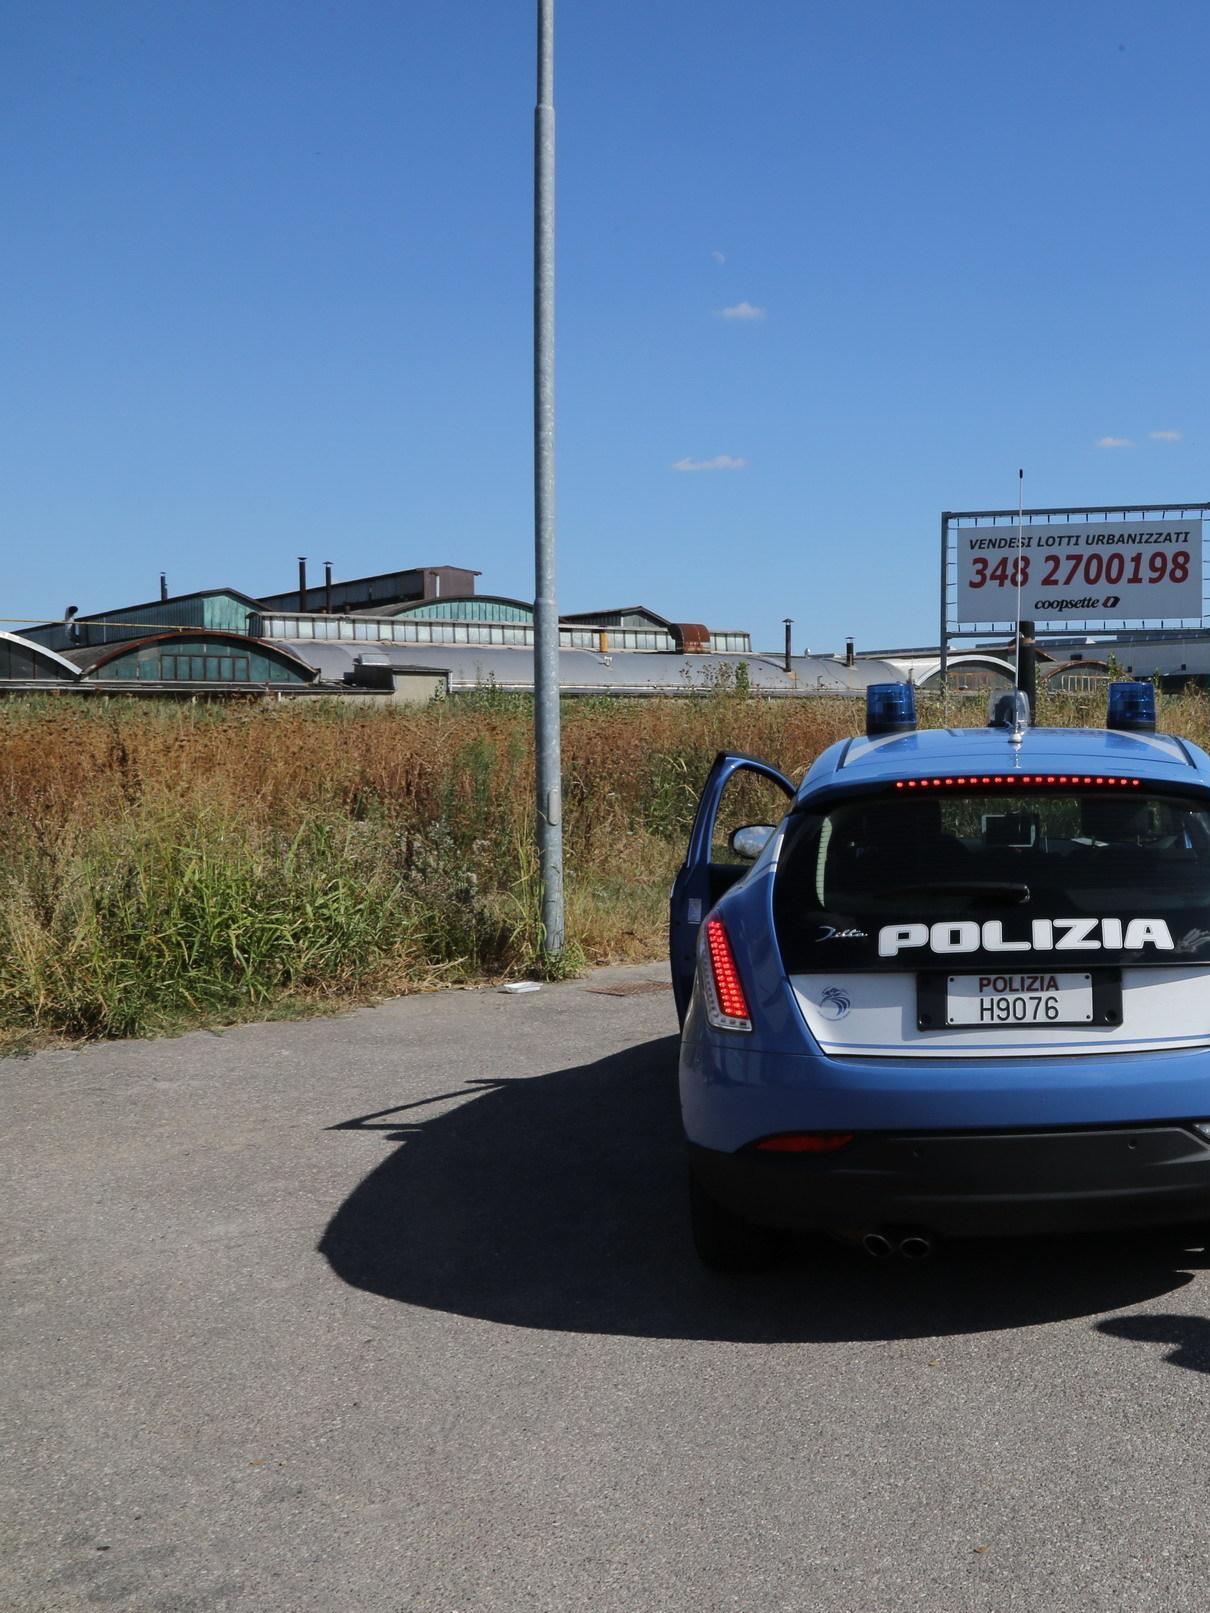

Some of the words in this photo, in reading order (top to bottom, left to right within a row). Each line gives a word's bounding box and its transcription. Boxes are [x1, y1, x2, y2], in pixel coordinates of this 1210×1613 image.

[969, 536, 1033, 550] VENDESI
[1037, 534, 1081, 547] LOTTI
[1085, 531, 1190, 546] URBANIZZATI
[968, 555, 1031, 589] 348
[1041, 550, 1191, 586] 2700198
[1034, 596, 1100, 612] coopsette
[878, 918, 1175, 956] POLIZIA
[979, 975, 1060, 993] POLIZIA
[979, 997, 1060, 1022] H9076
